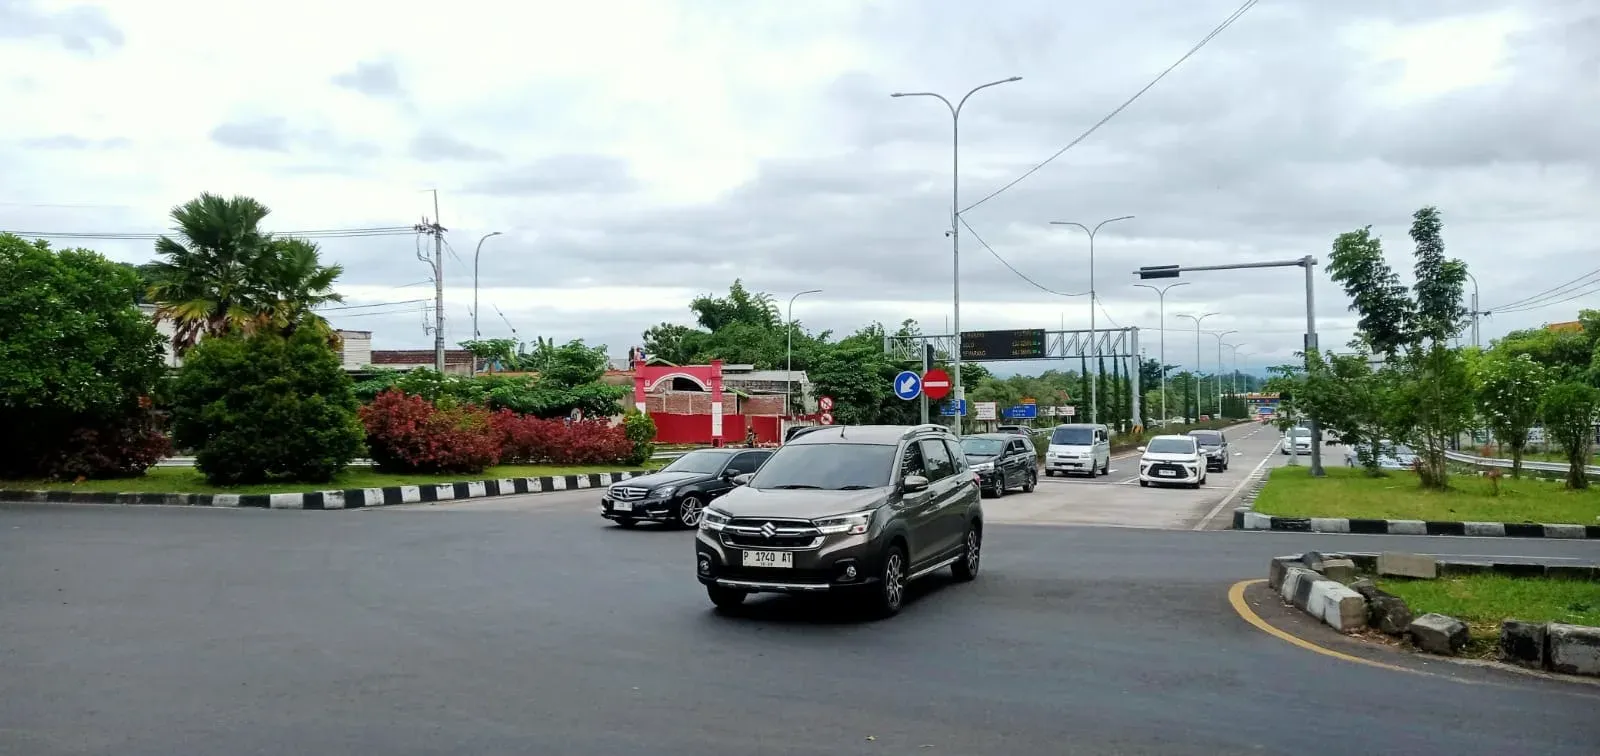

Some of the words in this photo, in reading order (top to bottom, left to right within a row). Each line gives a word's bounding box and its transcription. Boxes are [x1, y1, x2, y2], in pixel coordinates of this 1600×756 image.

[744, 552, 749, 561] P
[755, 552, 775, 562] 1740
[782, 552, 791, 563] AT
